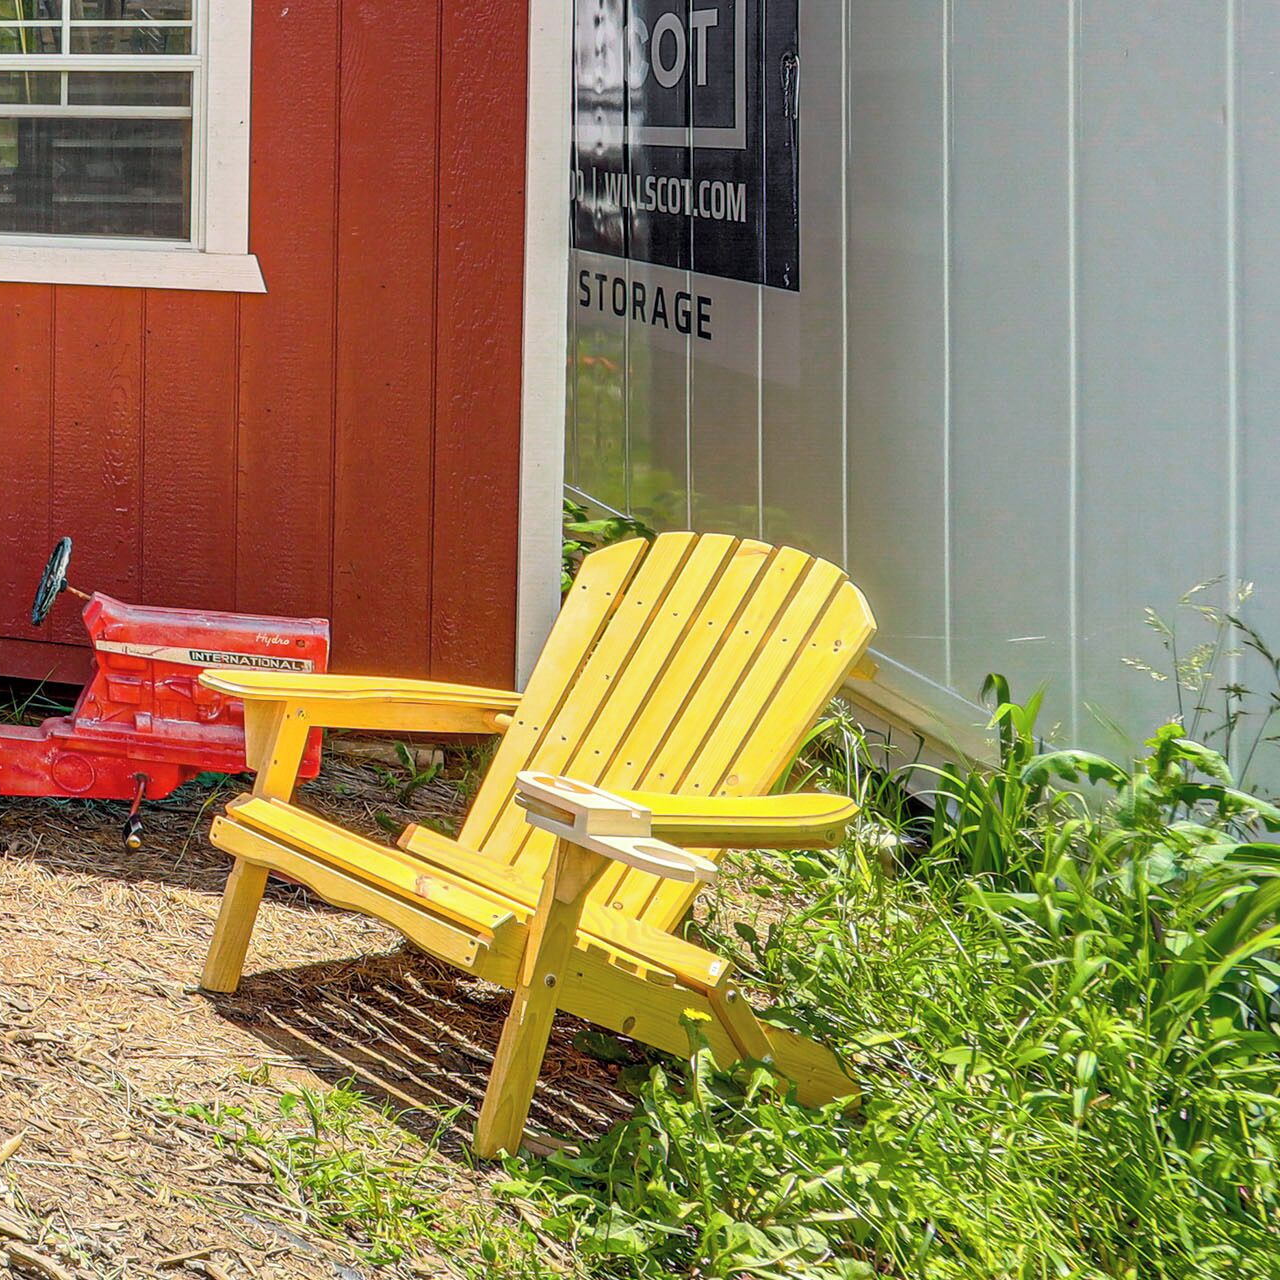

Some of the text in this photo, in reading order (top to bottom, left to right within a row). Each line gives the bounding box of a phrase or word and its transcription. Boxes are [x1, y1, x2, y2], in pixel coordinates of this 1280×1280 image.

[604, 171, 747, 223] WILLSCOT.COM
[578, 269, 713, 341] STORAGE
[255, 631, 291, 647] Hydro
[191, 651, 302, 671] INTERNATIONAL
